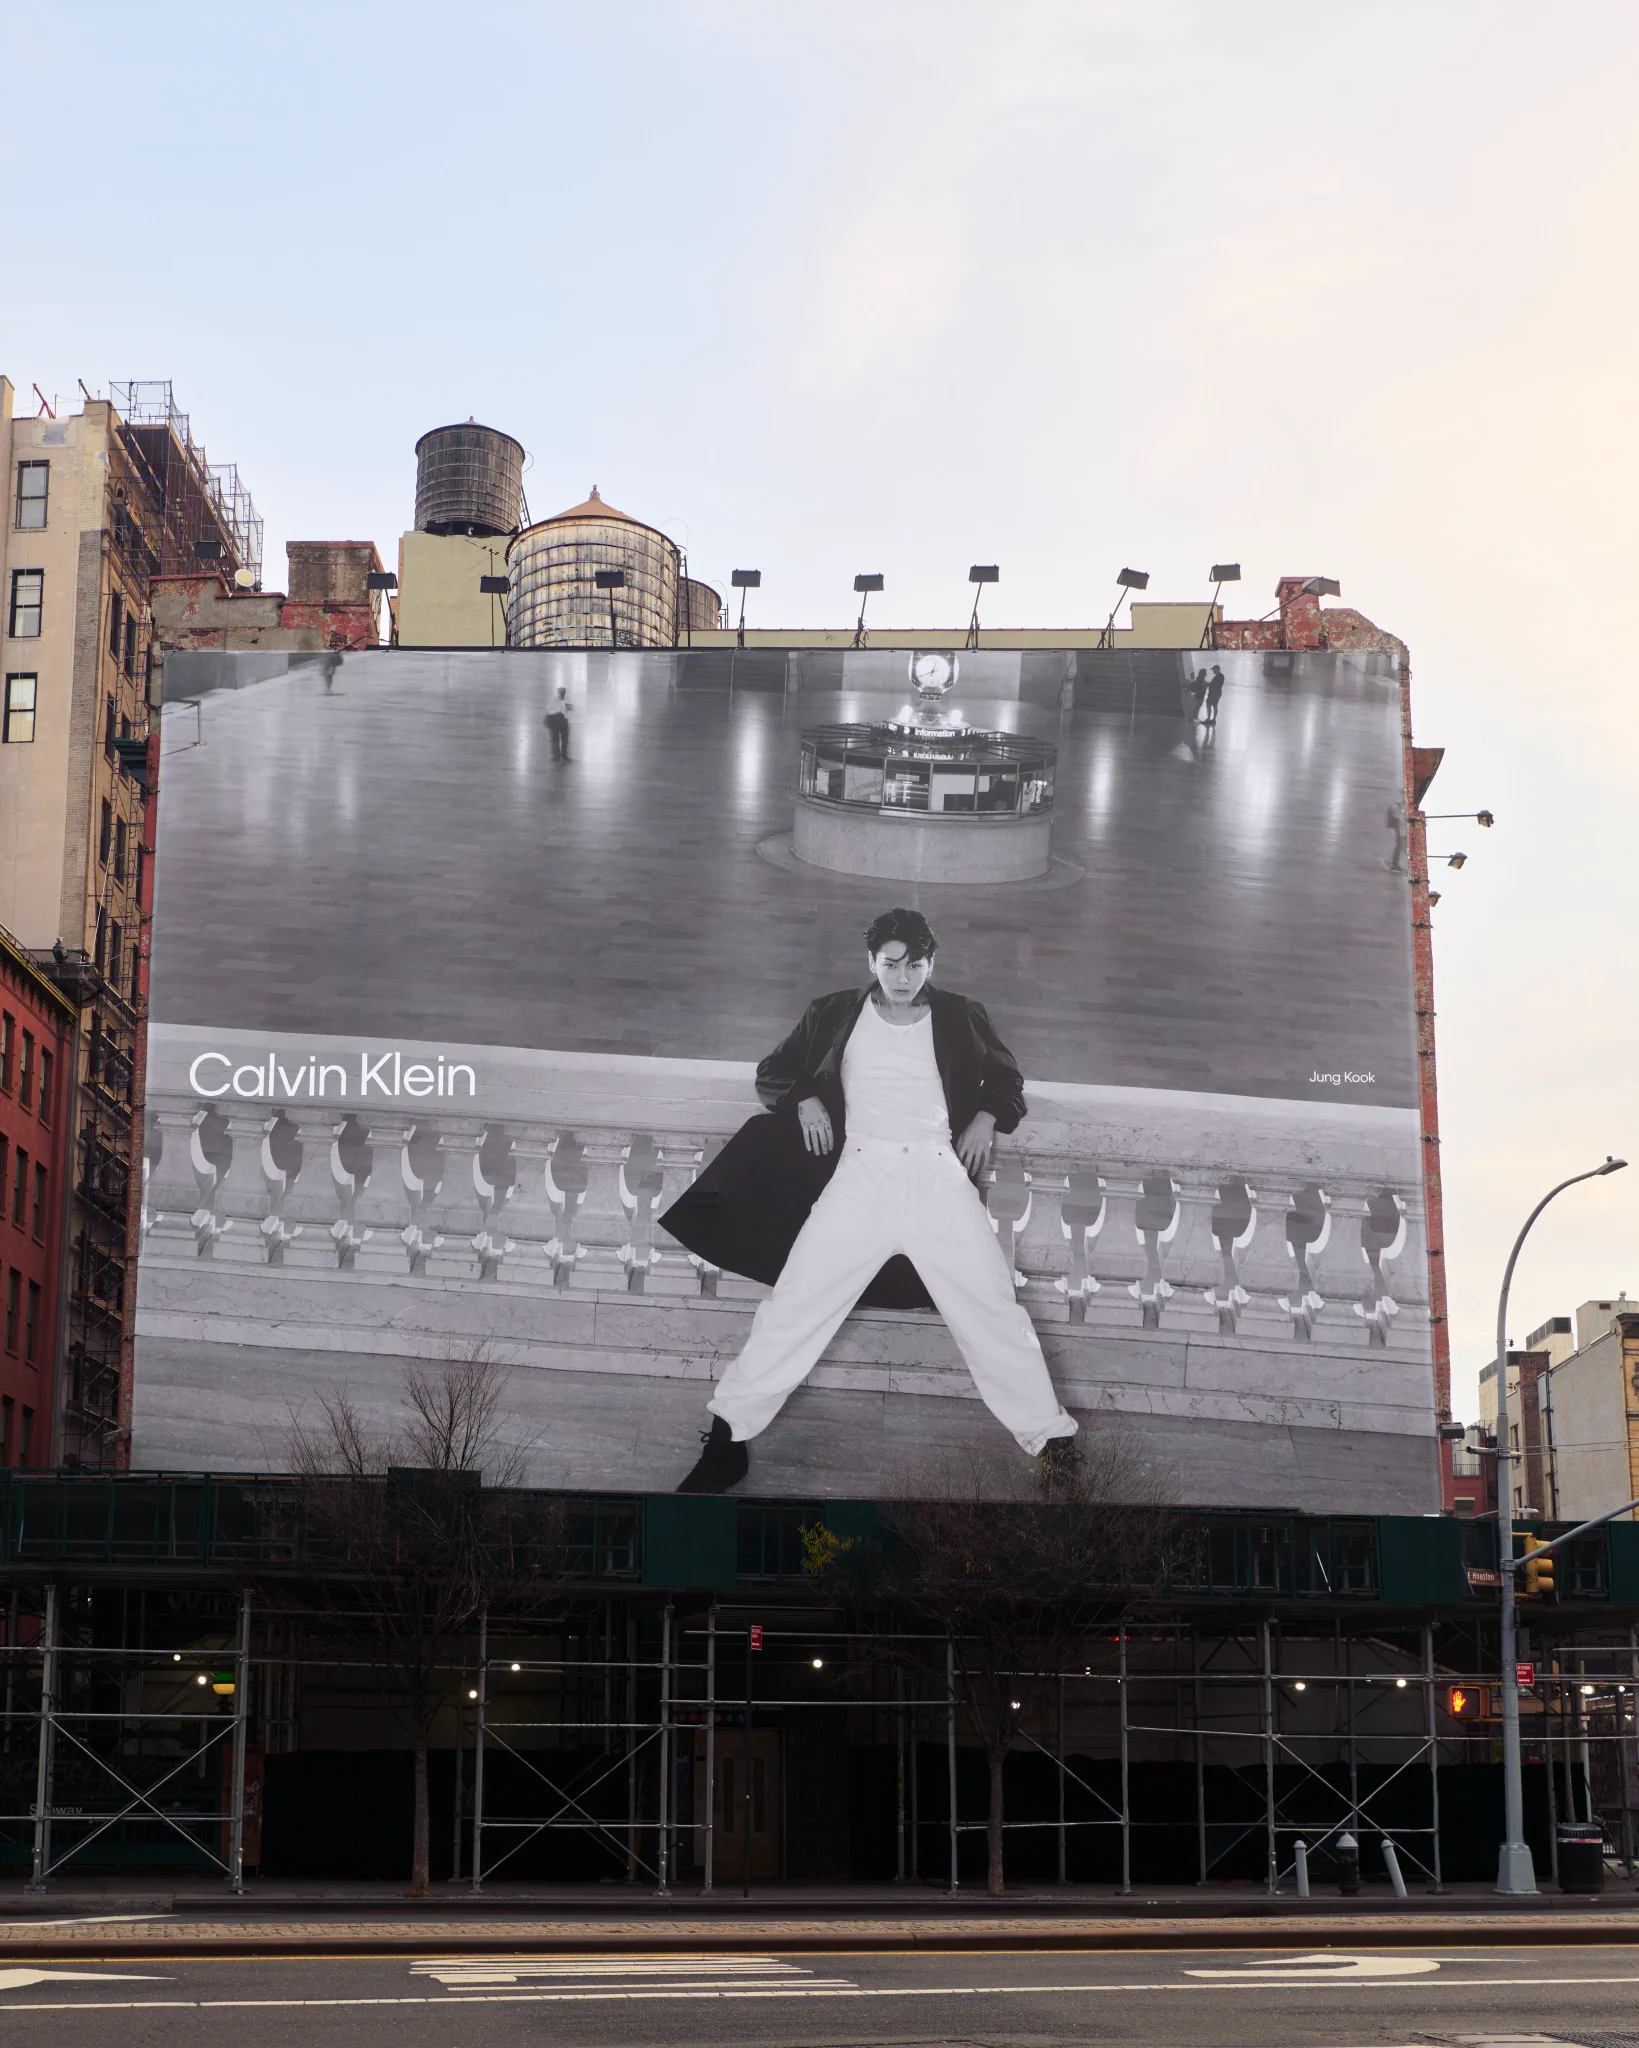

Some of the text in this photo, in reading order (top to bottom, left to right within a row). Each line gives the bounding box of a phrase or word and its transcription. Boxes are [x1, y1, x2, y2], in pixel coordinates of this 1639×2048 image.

[914, 728, 955, 738] Information
[189, 1051, 476, 1097] Calvin Klein
[1309, 1071, 1376, 1085] Jung Kook
[1472, 1572, 1495, 1581] Houston
